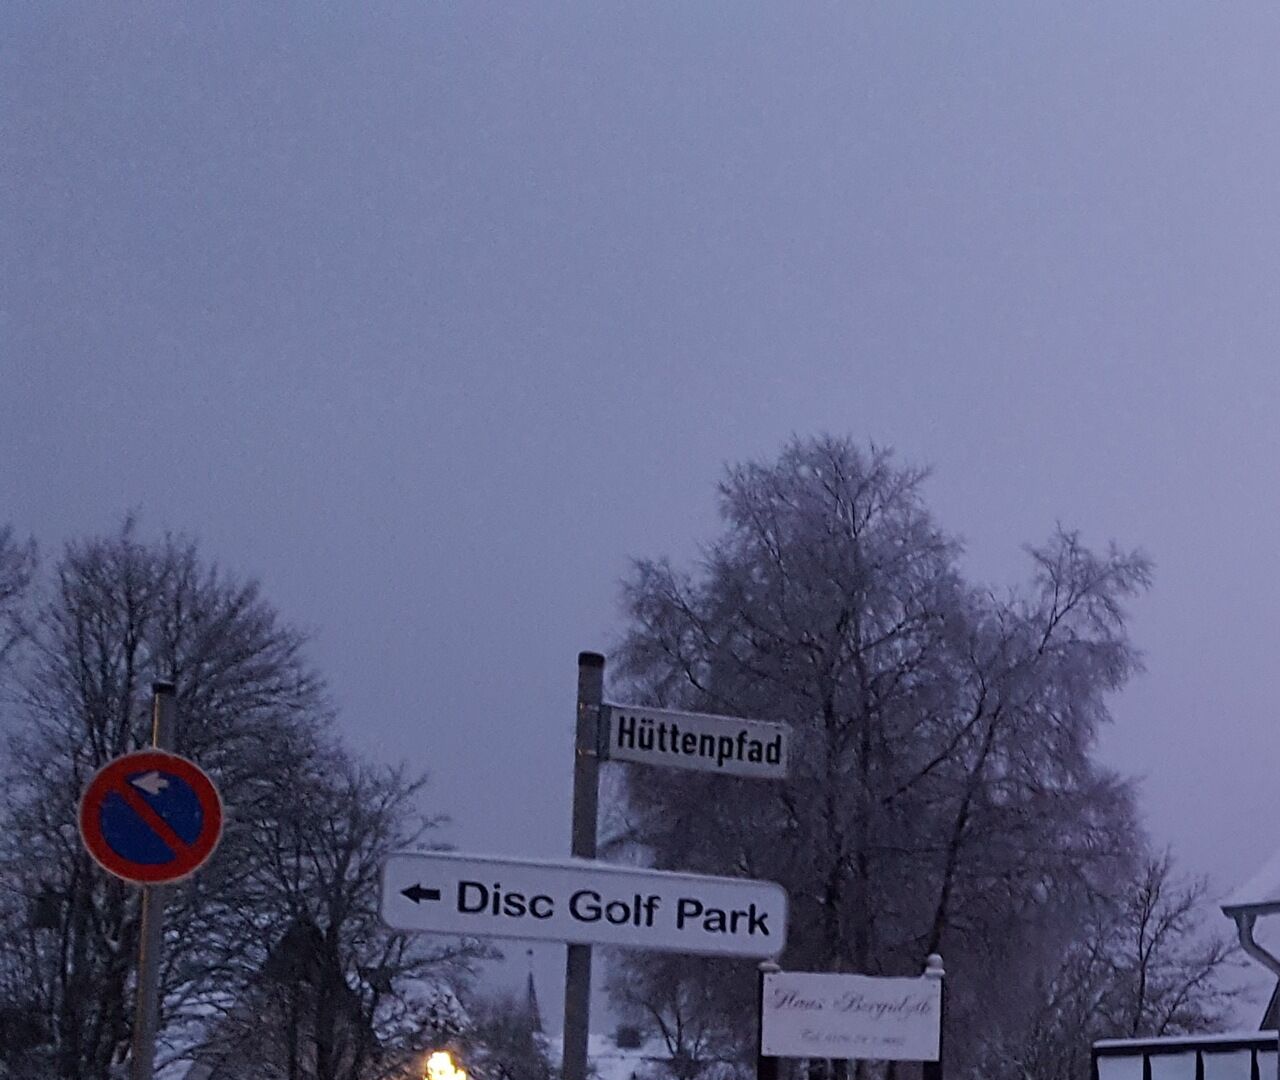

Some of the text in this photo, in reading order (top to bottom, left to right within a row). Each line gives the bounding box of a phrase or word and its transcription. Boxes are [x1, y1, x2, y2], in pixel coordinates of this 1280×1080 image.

[617, 716, 782, 767] Hüttenpfad
[457, 881, 771, 936] Disc Golf Park
